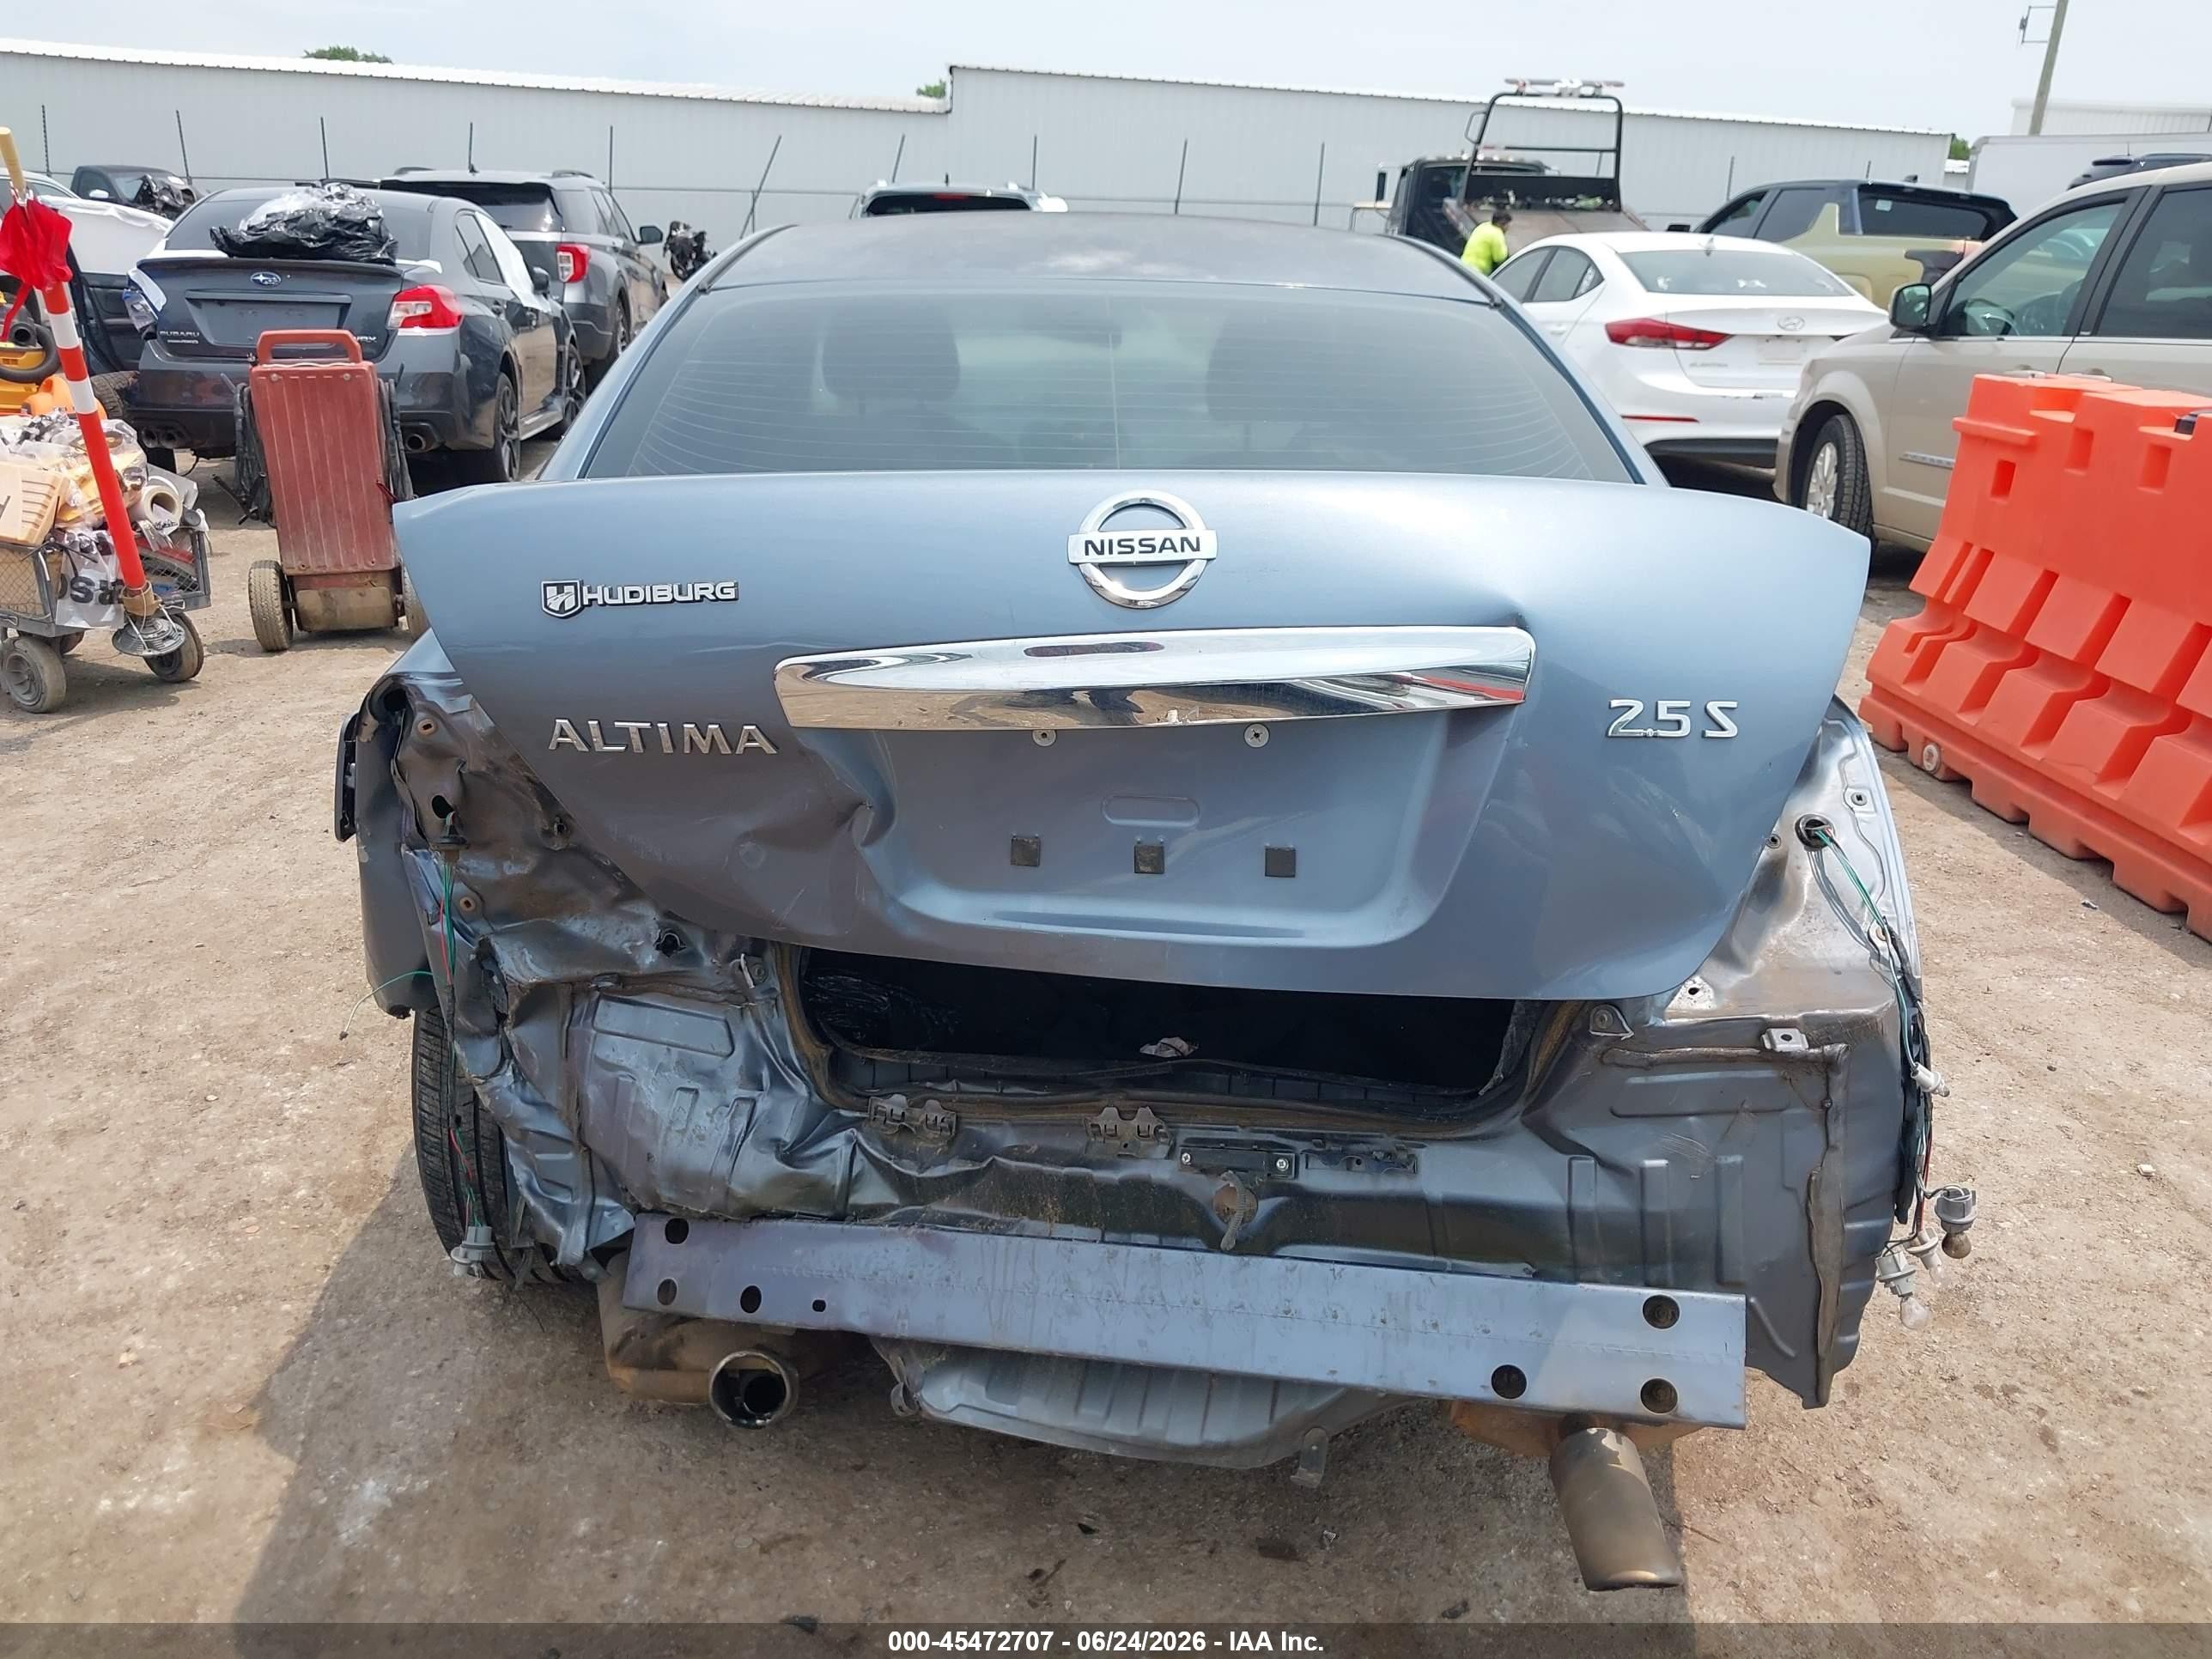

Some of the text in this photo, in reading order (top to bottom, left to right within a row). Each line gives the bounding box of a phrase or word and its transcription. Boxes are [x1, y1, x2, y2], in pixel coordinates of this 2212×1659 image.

[1085, 537, 1200, 556] NISSAN
[582, 580, 738, 606] HUDIBURG
[1704, 701, 1739, 738] S
[548, 718, 777, 755] ALTIMA
